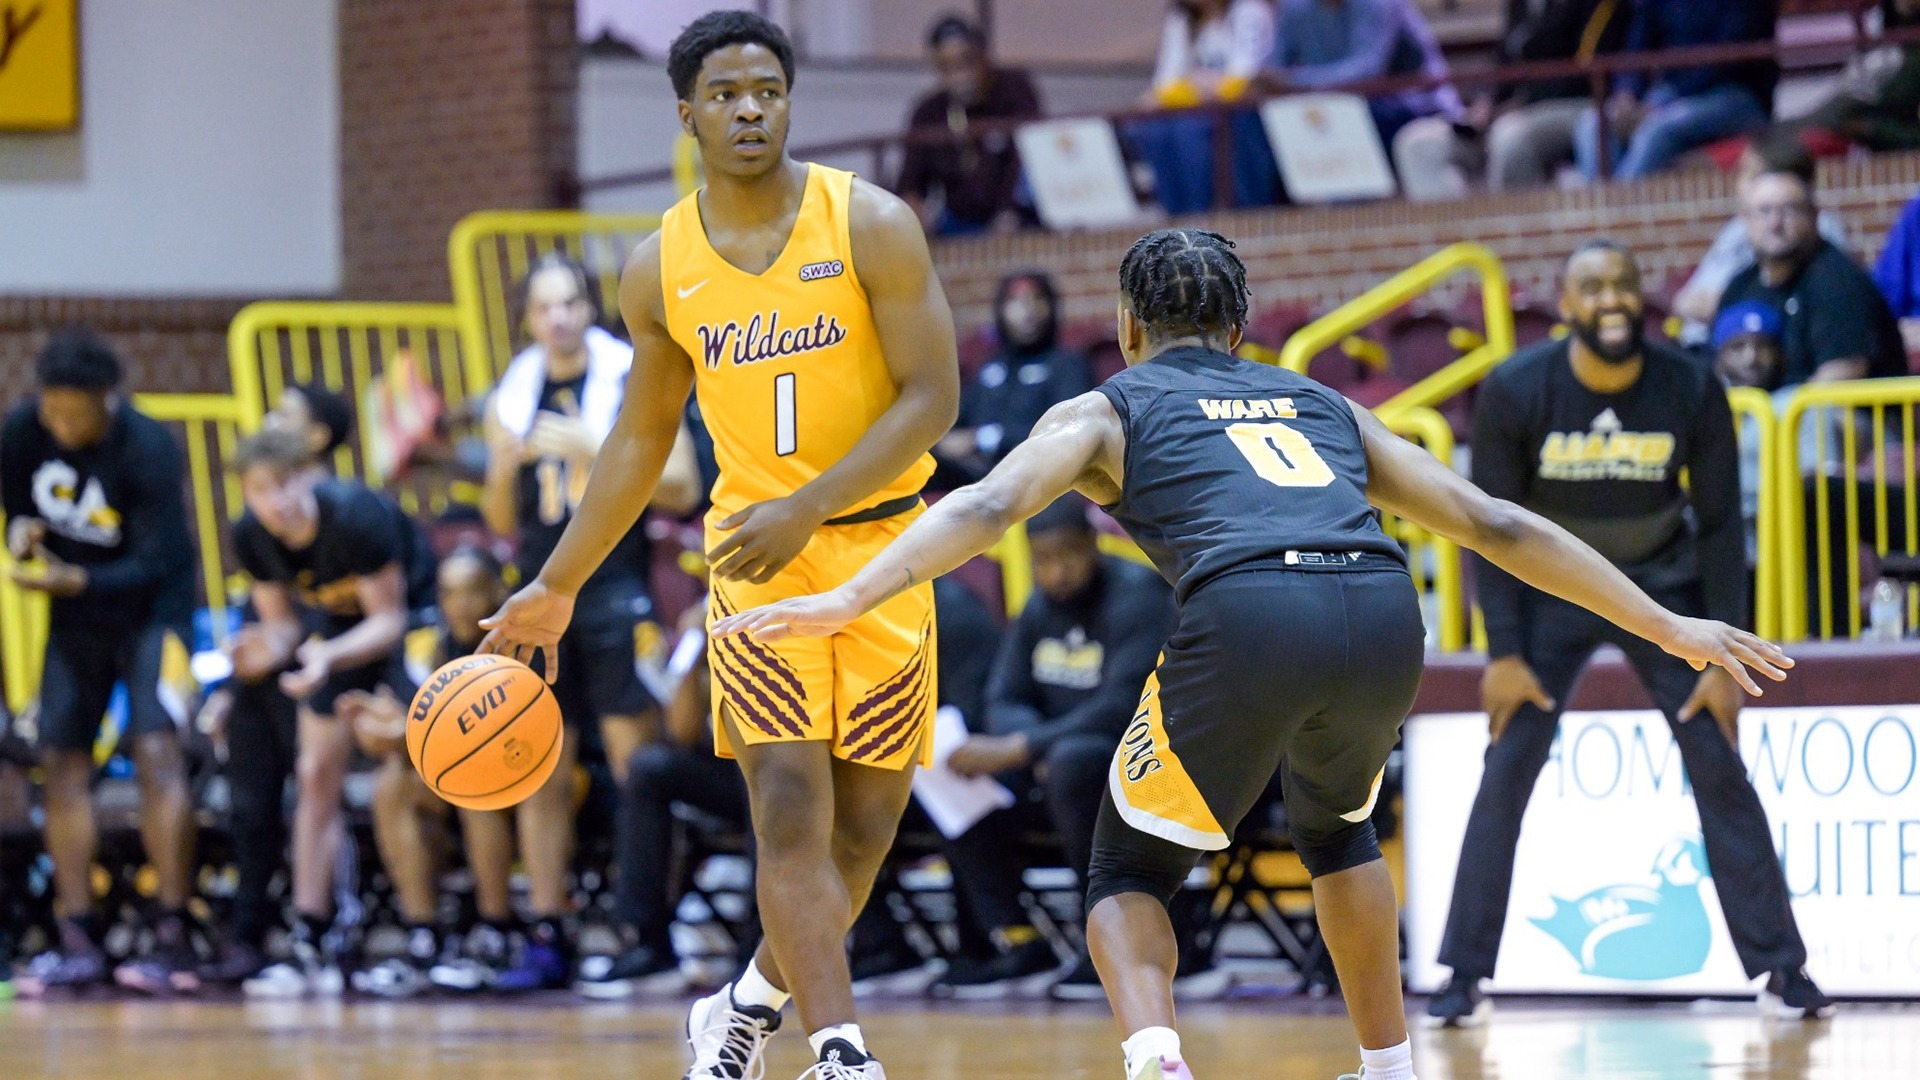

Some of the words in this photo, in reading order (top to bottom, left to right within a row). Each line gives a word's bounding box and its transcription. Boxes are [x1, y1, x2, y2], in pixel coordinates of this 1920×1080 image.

[801, 261, 842, 279] SWAC
[698, 311, 846, 369] Wildcats
[774, 372, 797, 457] 1
[1197, 397, 1298, 420] WARE
[1224, 422, 1337, 487] 0
[457, 684, 507, 736] EVO
[1780, 819, 1920, 898] UITE
